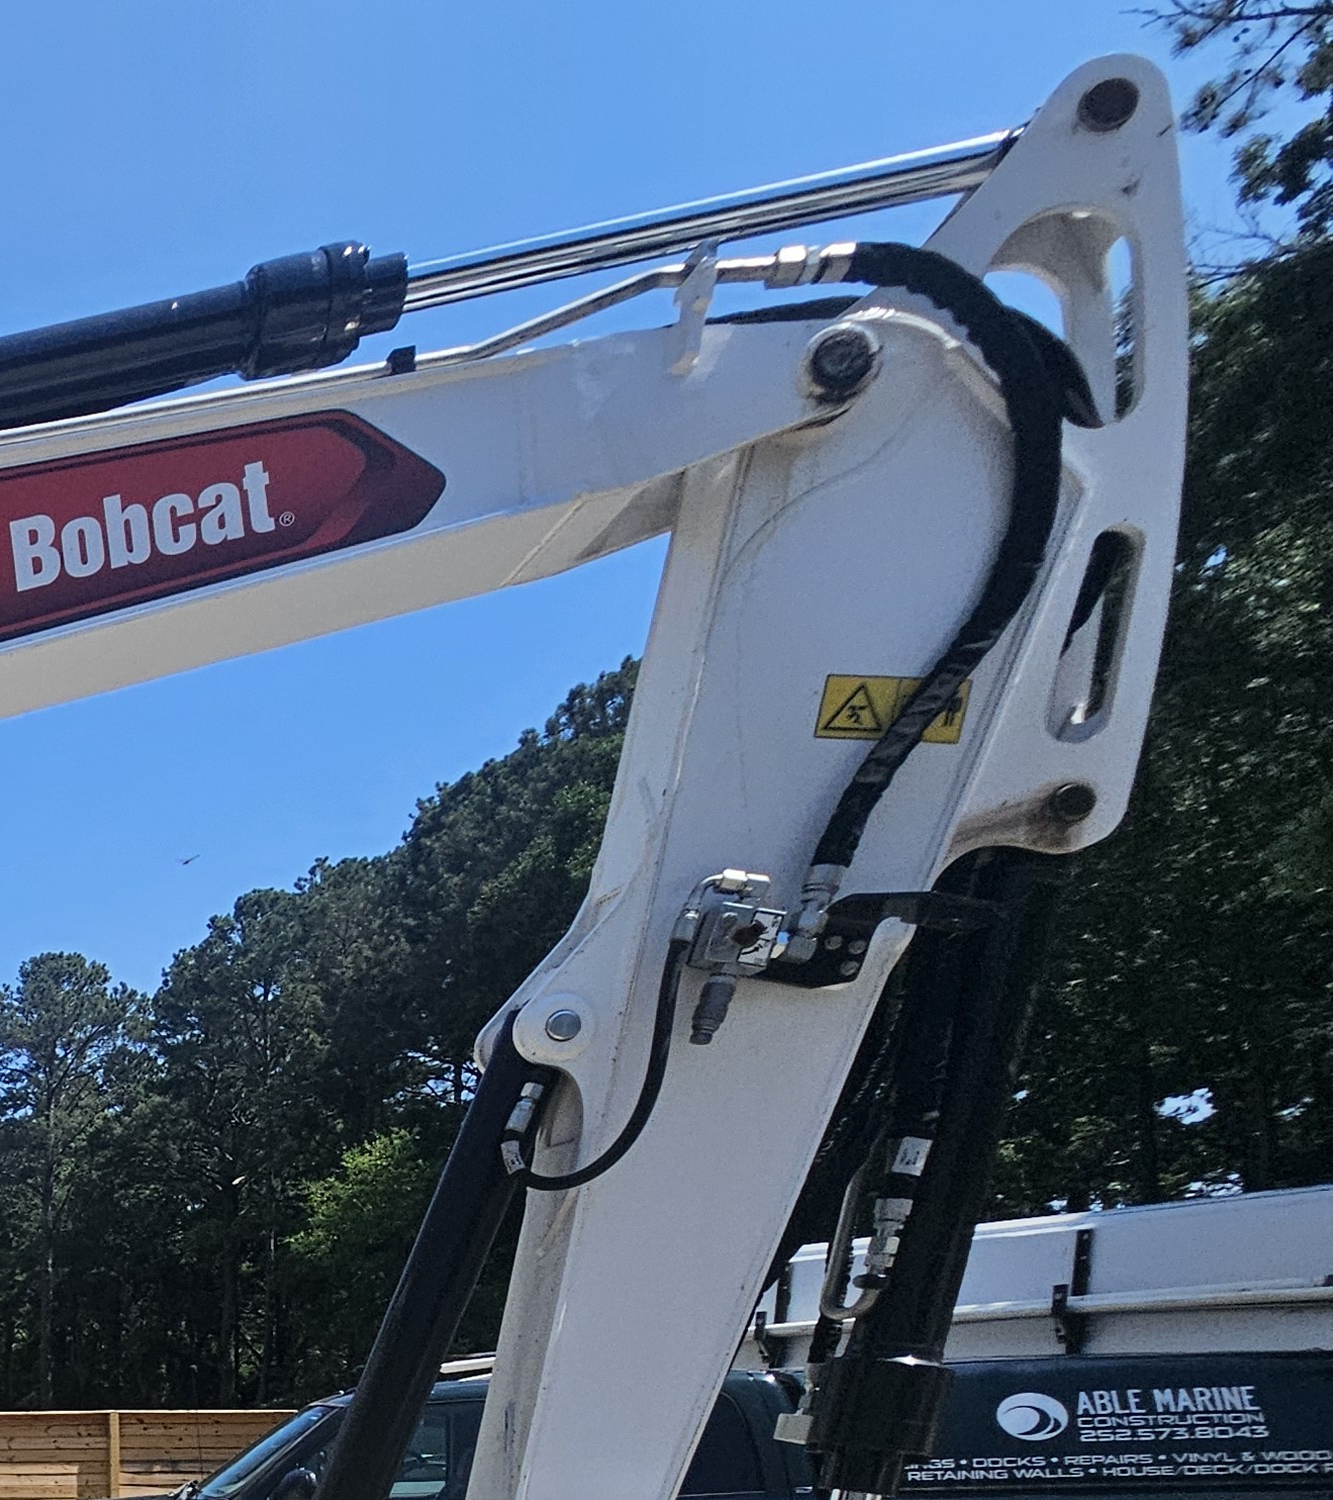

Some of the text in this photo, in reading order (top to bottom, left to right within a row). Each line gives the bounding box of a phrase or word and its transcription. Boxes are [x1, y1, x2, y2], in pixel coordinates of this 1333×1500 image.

[9, 461, 276, 592] Bobcat
[1076, 1386, 1261, 1415] ABLE MARINE
[1077, 1413, 1265, 1428] CONSTRUCTION
[1079, 1425, 1269, 1442] 252.573.8043
[972, 1450, 1332, 1468] DOCKS REPAIRS VINYL & WOOD
[907, 1469, 1009, 1481] RETAINING
[1013, 1467, 1084, 1479] WALLS
